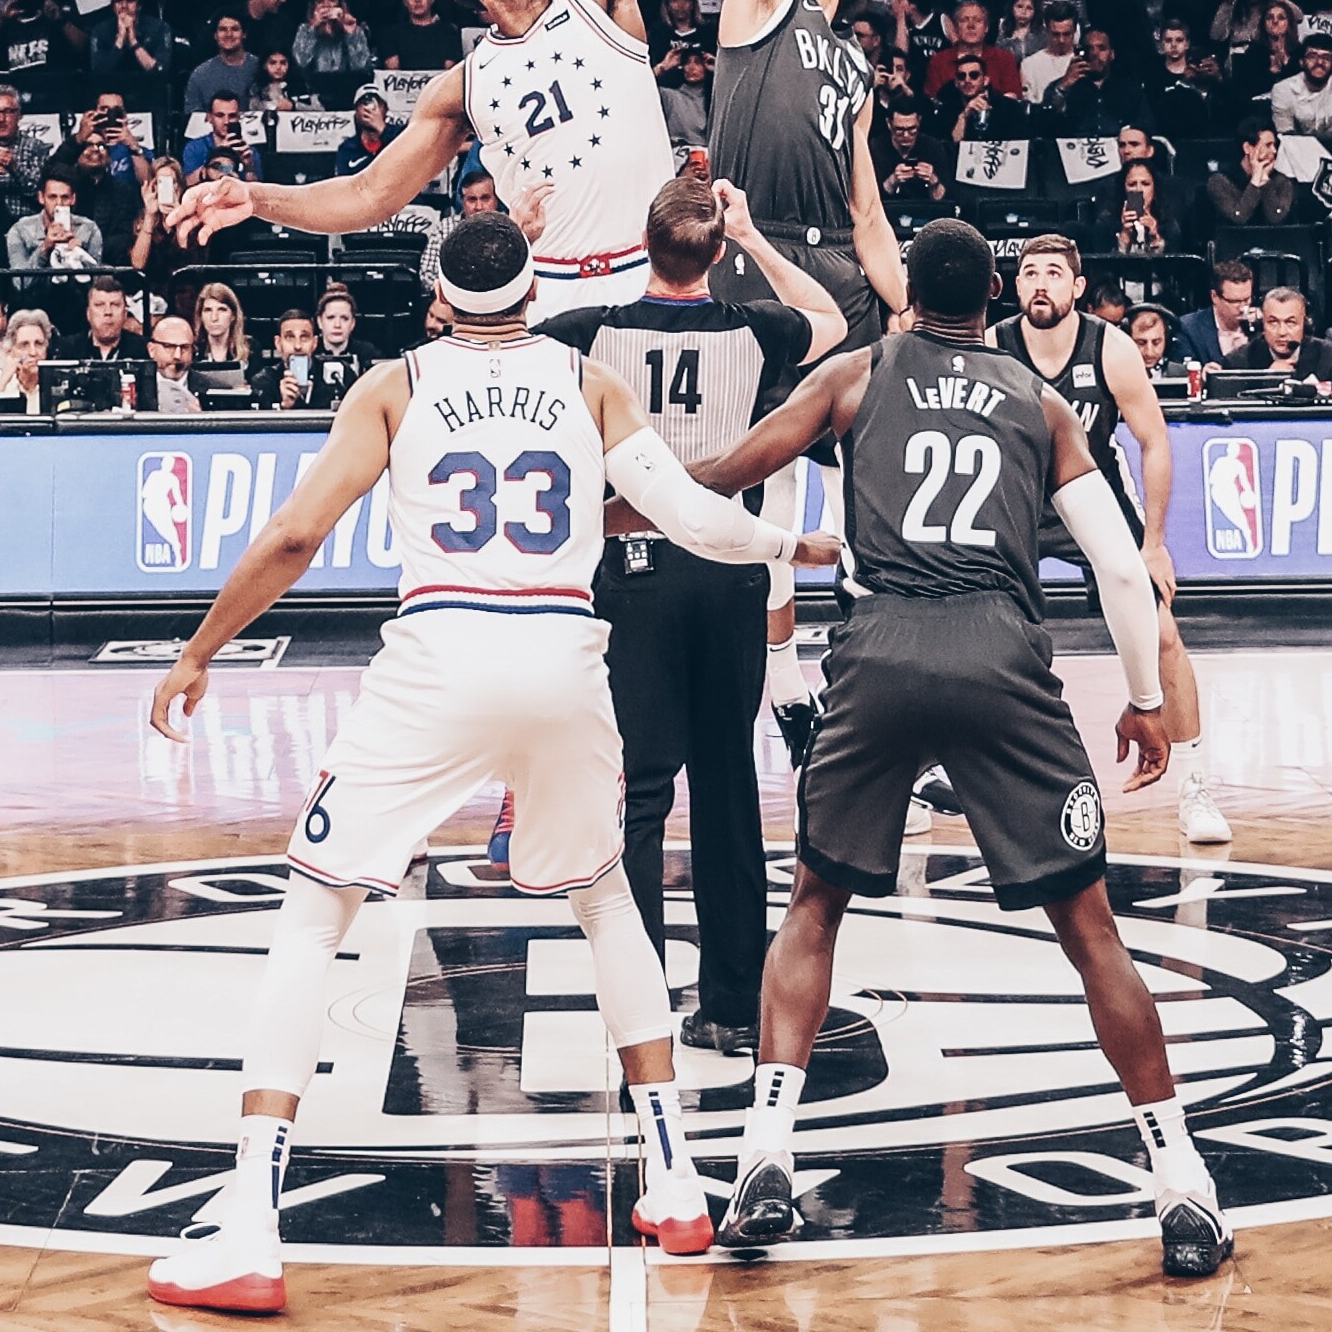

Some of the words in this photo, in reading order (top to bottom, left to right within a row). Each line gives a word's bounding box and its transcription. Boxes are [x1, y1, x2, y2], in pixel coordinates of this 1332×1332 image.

[287, 117, 350, 137] PLAYOFFS
[518, 79, 574, 138] 21
[818, 85, 850, 150] 31
[645, 349, 702, 414] 14
[906, 376, 1006, 418] LeVERT
[433, 386, 566, 433] HARRIS
[428, 451, 571, 555] 33
[903, 431, 1001, 548] 22
[144, 543, 172, 565] NBA
[1215, 530, 1243, 551] NBA
